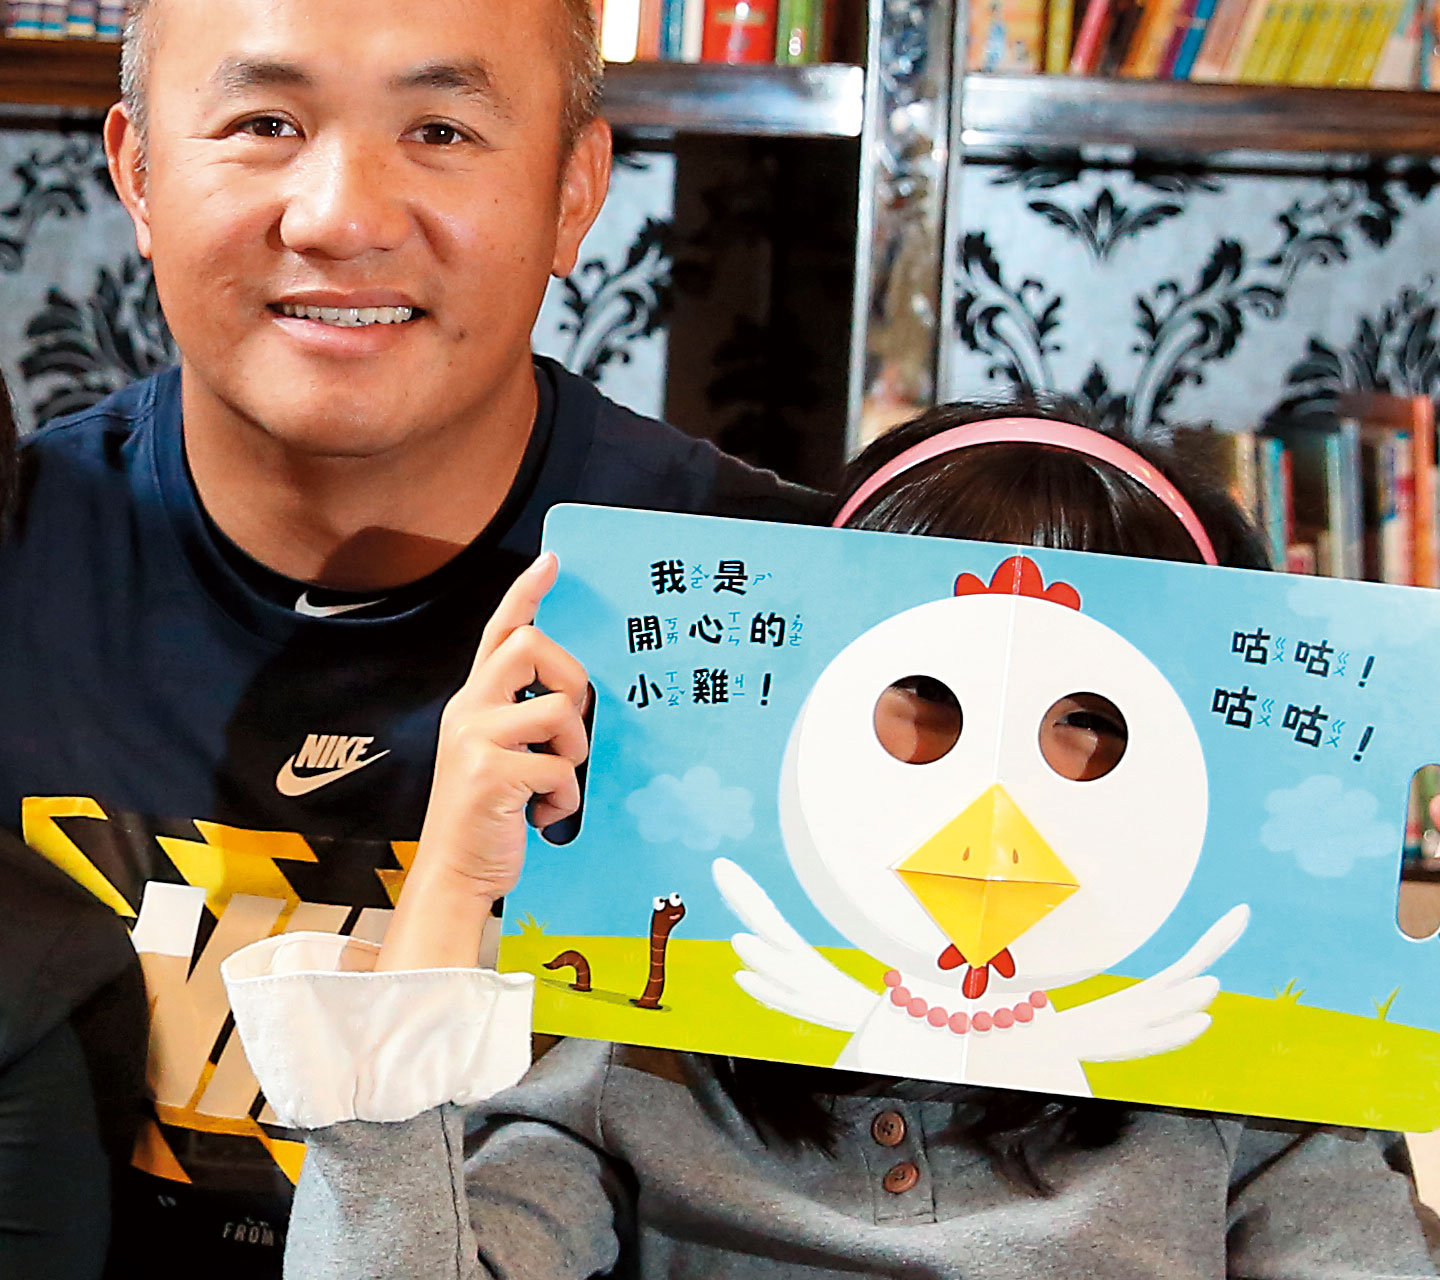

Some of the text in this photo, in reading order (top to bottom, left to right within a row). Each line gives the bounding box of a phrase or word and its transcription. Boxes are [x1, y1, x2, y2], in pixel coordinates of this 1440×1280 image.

[649, 558, 750, 596] 我是
[626, 611, 787, 655] 開心的
[1231, 627, 1376, 689] 咕咕！
[626, 667, 773, 710] 小雞！
[1210, 685, 1375, 763] 咕咕！
[293, 733, 376, 769] NIKE
[222, 1222, 275, 1247] FROM
